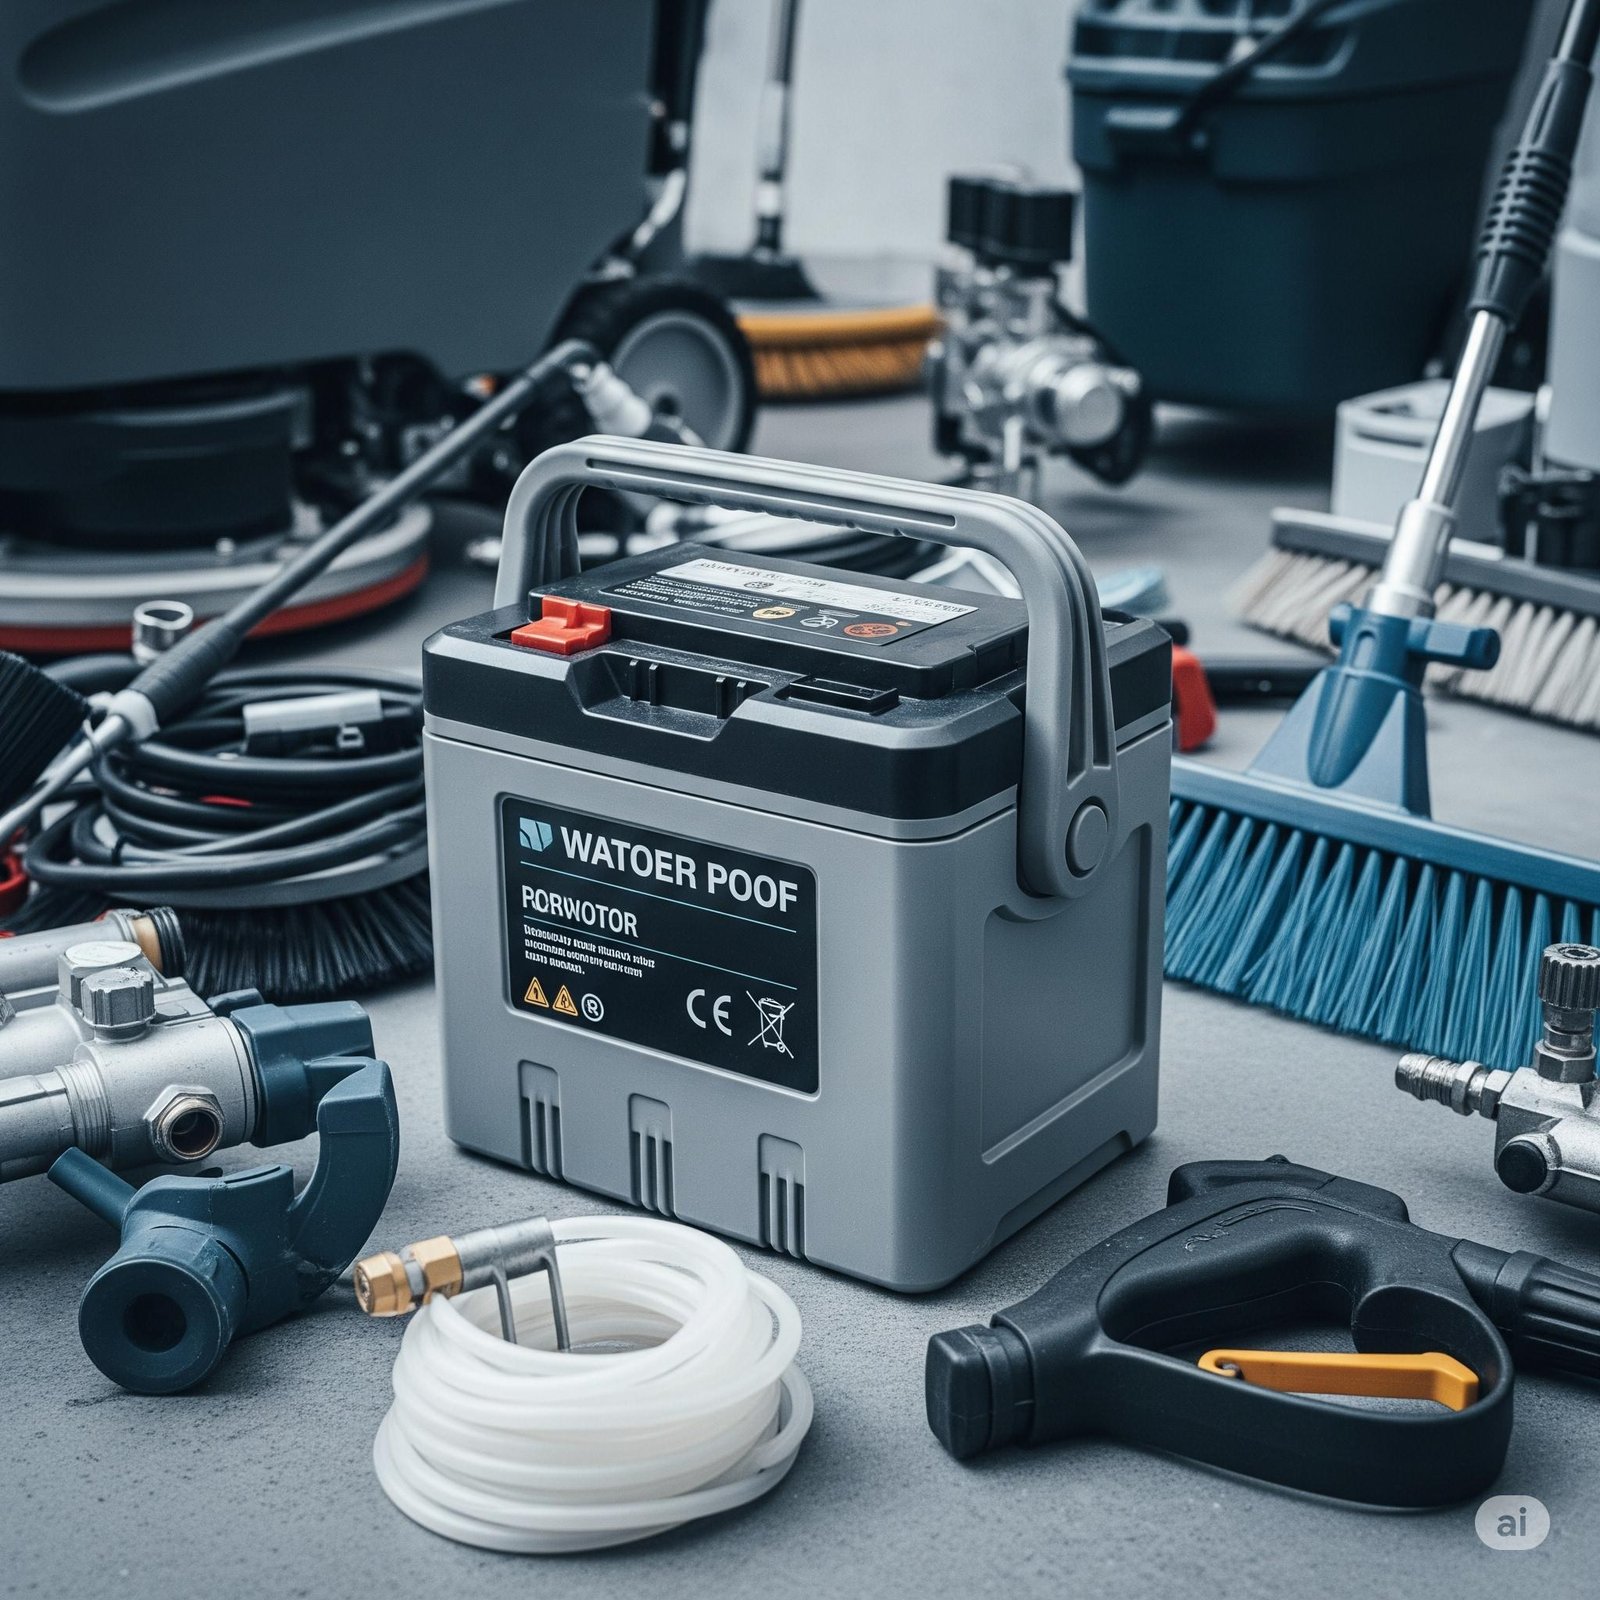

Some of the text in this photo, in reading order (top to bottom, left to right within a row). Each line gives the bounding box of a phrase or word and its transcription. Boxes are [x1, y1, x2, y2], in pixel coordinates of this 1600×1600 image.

[560, 826, 798, 913] WATOER POOF
[686, 988, 732, 1036] CE
